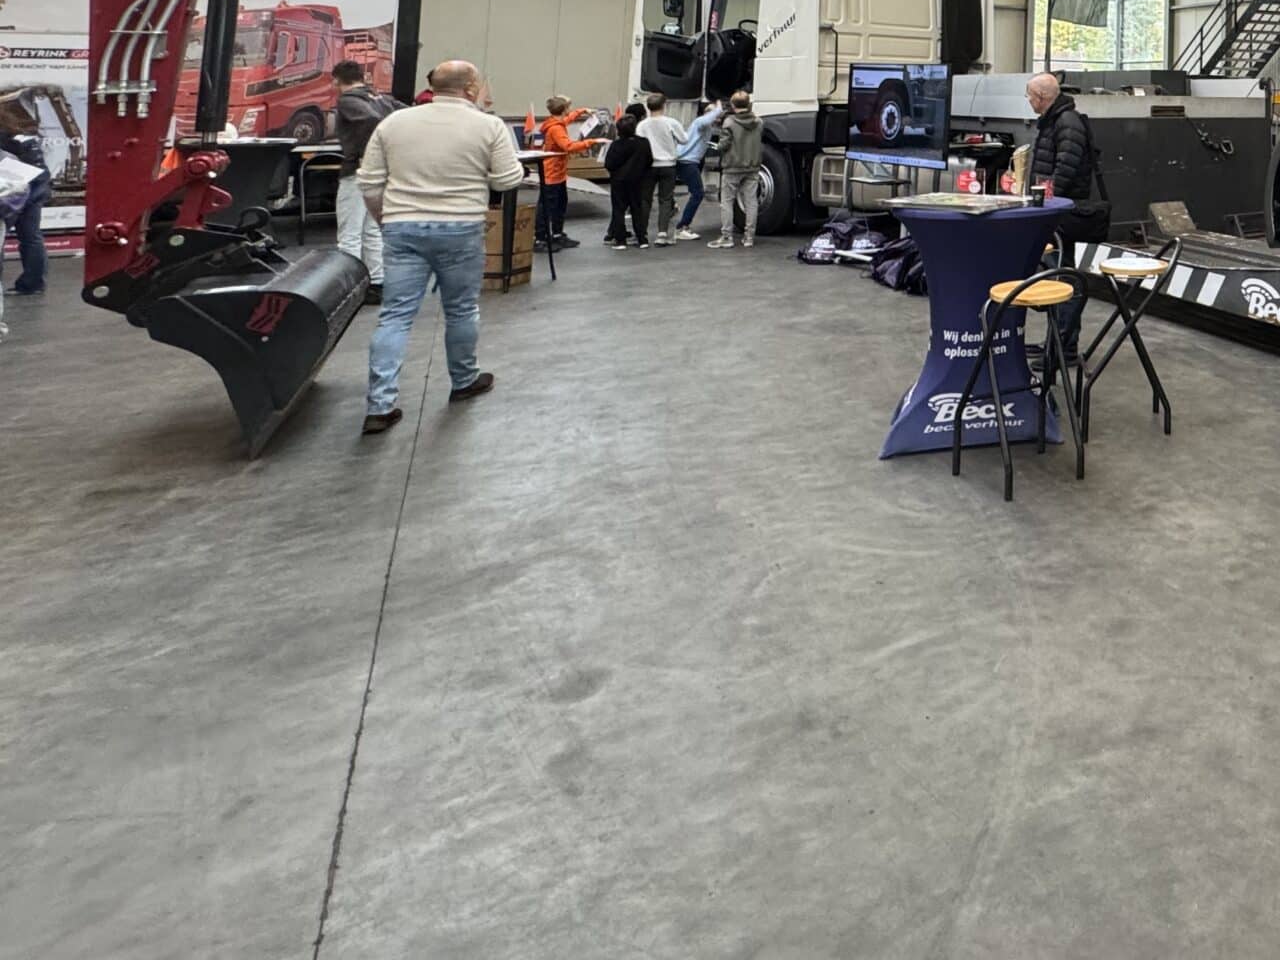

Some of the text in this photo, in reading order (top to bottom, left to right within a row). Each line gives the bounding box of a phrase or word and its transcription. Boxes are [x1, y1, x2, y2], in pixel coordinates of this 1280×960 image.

[12, 49, 69, 58] REYRINK
[943, 330, 959, 344] Wij
[1001, 328, 1010, 339] in
